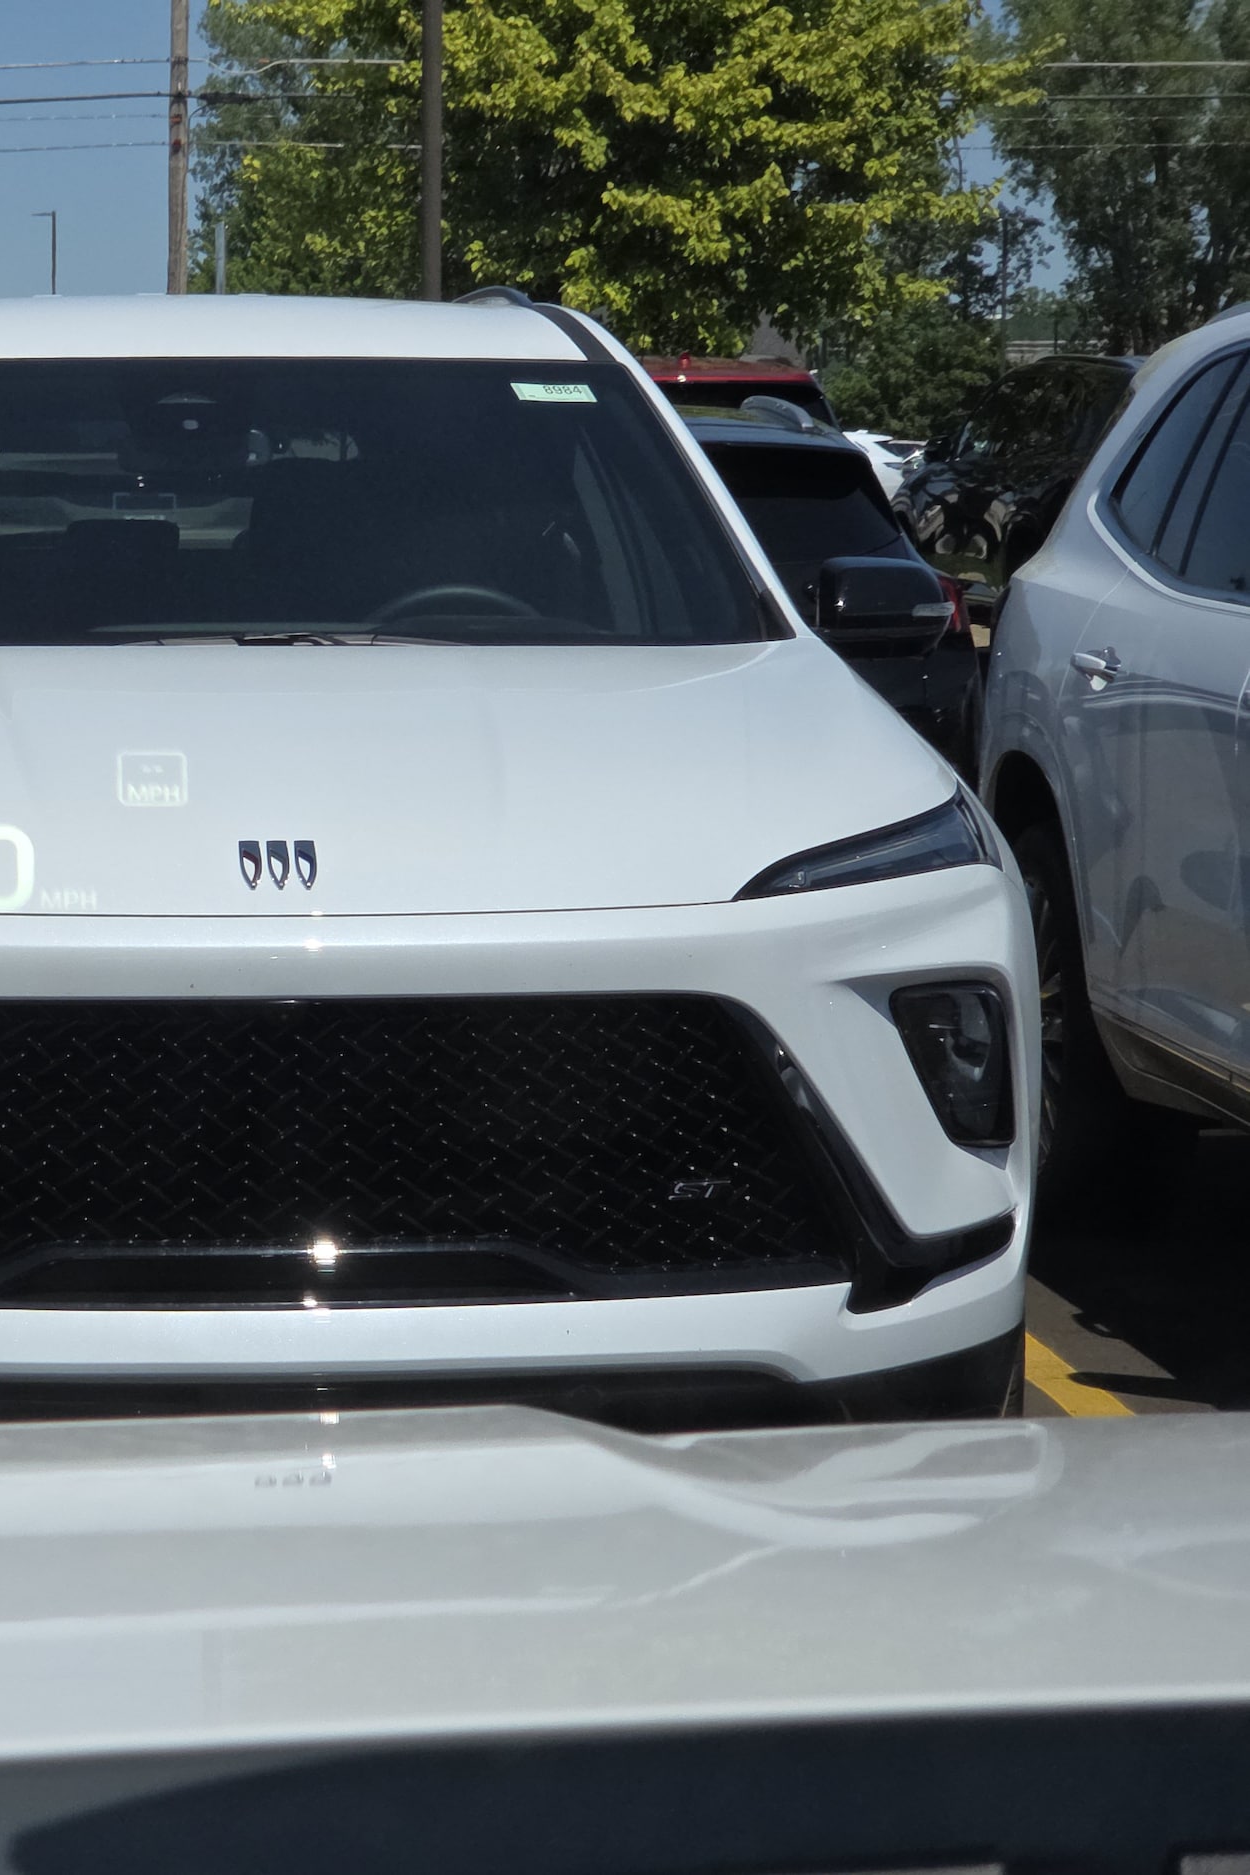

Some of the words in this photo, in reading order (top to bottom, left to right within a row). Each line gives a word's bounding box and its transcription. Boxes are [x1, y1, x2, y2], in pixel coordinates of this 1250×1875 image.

[127, 783, 180, 802] MPH
[40, 888, 98, 911] MPH
[668, 1180, 731, 1200] ST
